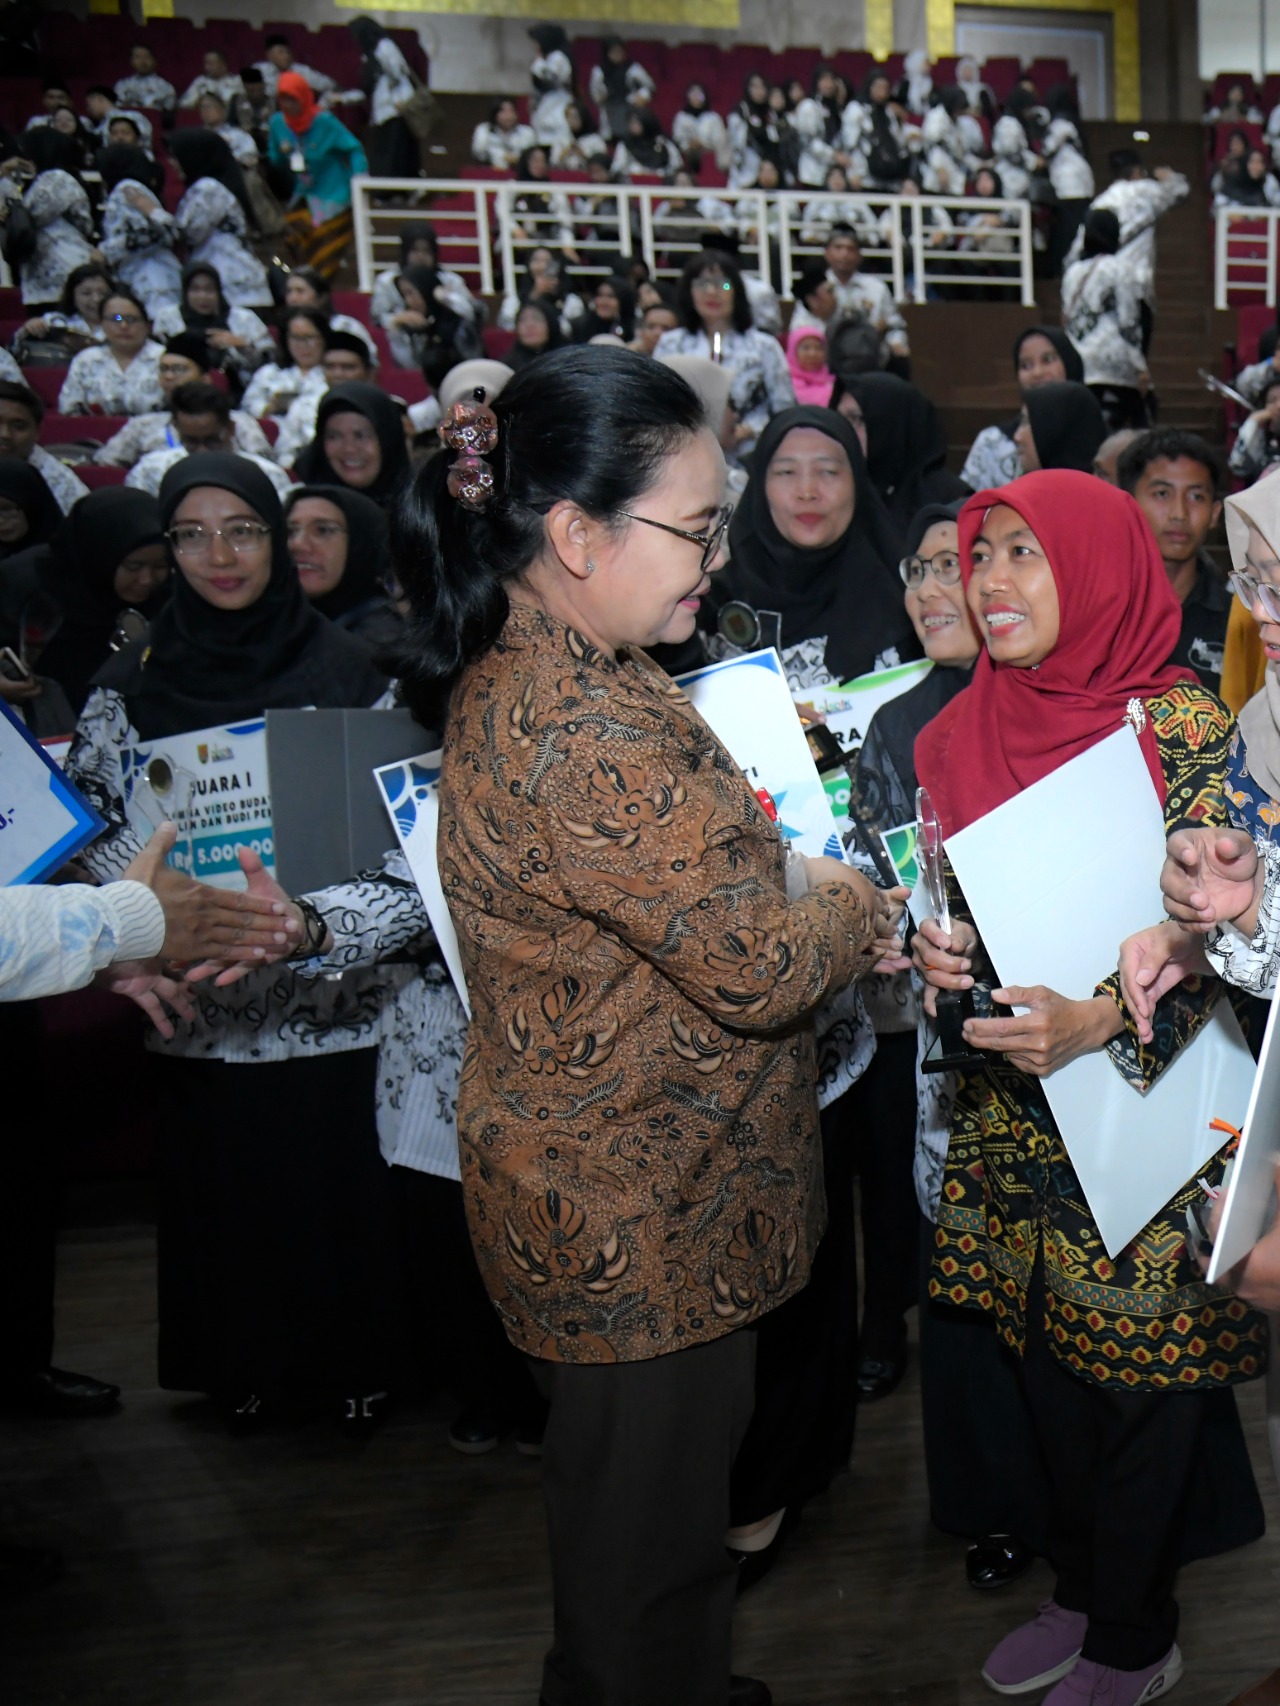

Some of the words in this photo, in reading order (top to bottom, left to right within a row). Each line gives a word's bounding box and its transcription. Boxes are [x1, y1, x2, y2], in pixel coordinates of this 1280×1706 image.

[204, 802, 236, 815] VIDEO
[240, 795, 272, 809] BUDA
[201, 817, 222, 829] DAN
[226, 812, 250, 824] BUDI
